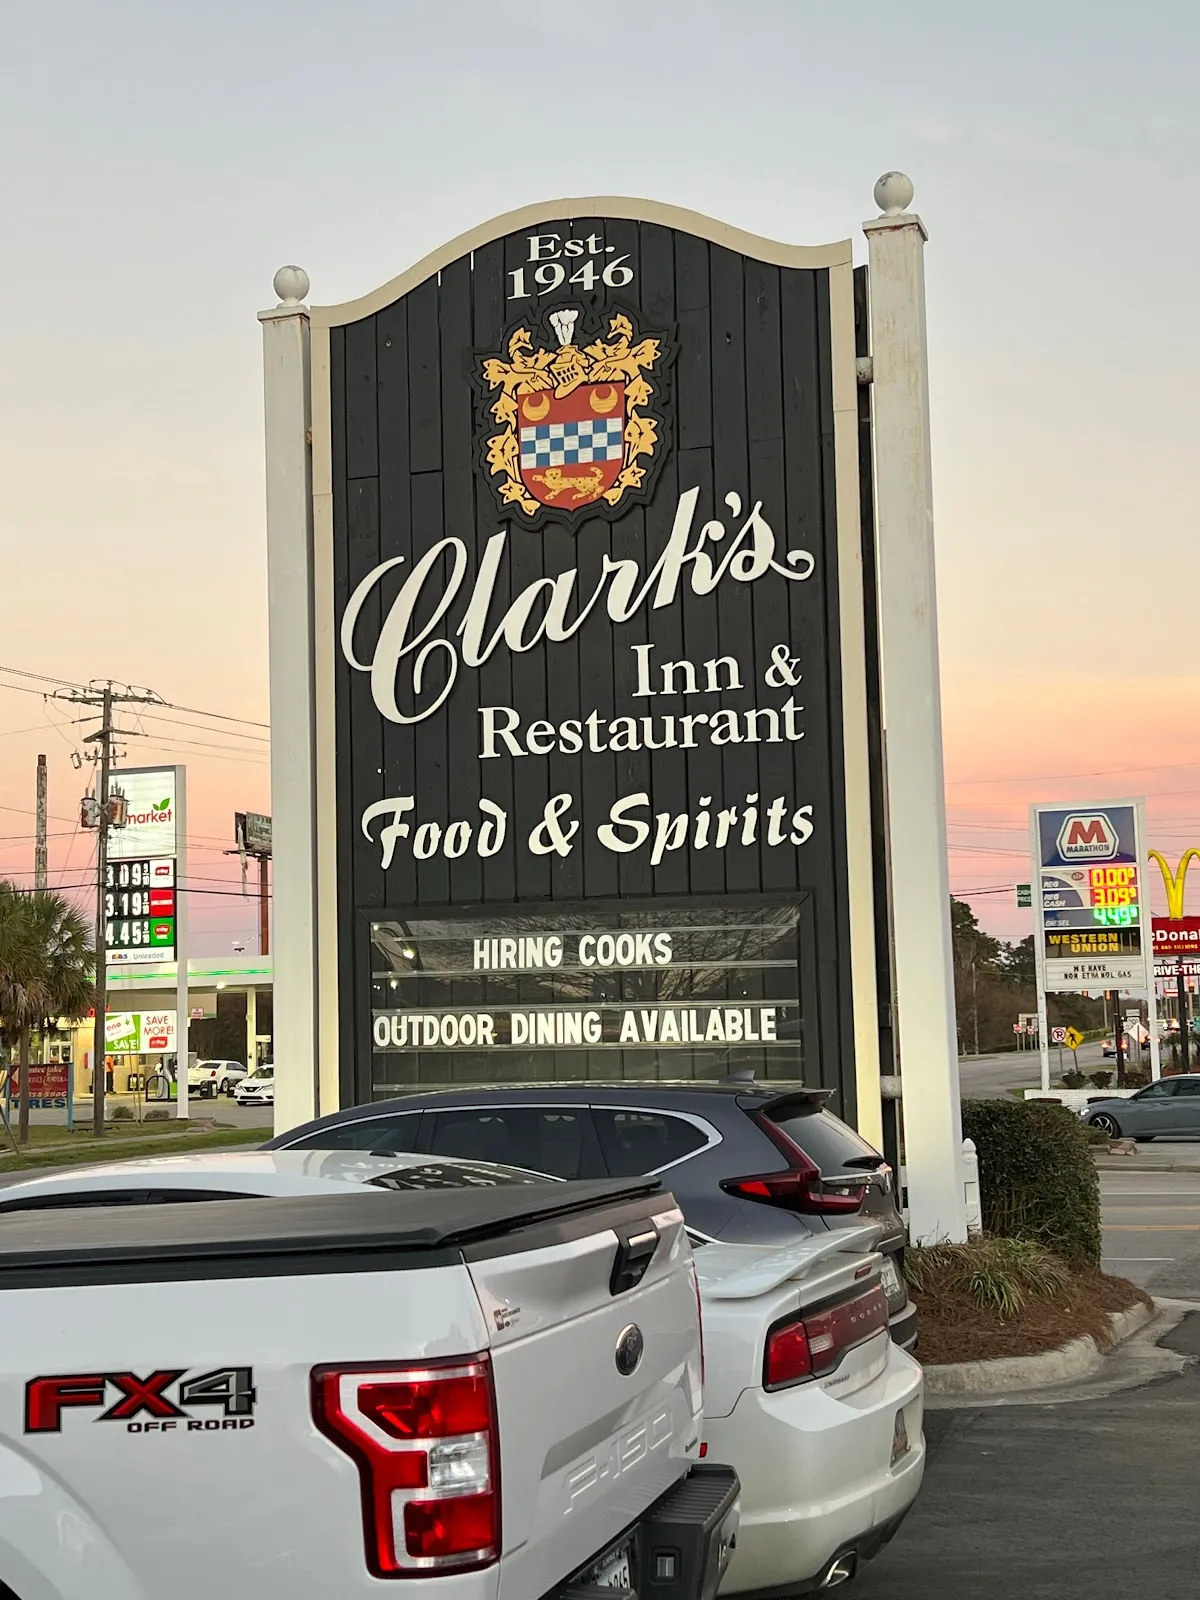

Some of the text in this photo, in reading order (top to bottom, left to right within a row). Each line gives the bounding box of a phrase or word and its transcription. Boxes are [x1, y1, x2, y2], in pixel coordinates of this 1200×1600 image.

[527, 232, 616, 263] Est.
[506, 253, 635, 300] 1946
[340, 485, 815, 725] Clark's
[630, 643, 803, 698] Inn &
[477, 695, 805, 759] Restaurant
[126, 808, 173, 825] market
[361, 792, 815, 870] Food & Spirits
[1066, 843, 1110, 853] MARATHON
[1043, 880, 1059, 888] REG
[105, 892, 142, 917] 3.19
[1044, 893, 1060, 901] REG
[105, 921, 142, 946] 4.45
[1048, 932, 1119, 945] WESTERN
[1151, 929, 1200, 942] cDonal
[473, 932, 673, 970] HIRING COOKS
[1070, 942, 1119, 954] UNION
[1082, 971, 1115, 980] ETHANOL
[1118, 970, 1132, 978] GAS
[1088, 964, 1107, 972] HAVE
[1153, 963, 1200, 976] RIVE-TH
[146, 1015, 169, 1026] SAVE
[373, 1008, 777, 1048] OUTDOOR DINING AVAILABLE
[143, 1026, 175, 1036] MORE!
[10, 1098, 66, 1109] TRES
[24, 1366, 258, 1435] FX4
[127, 1418, 255, 1433] OFF ROAD
[561, 1407, 674, 1516] F-150
